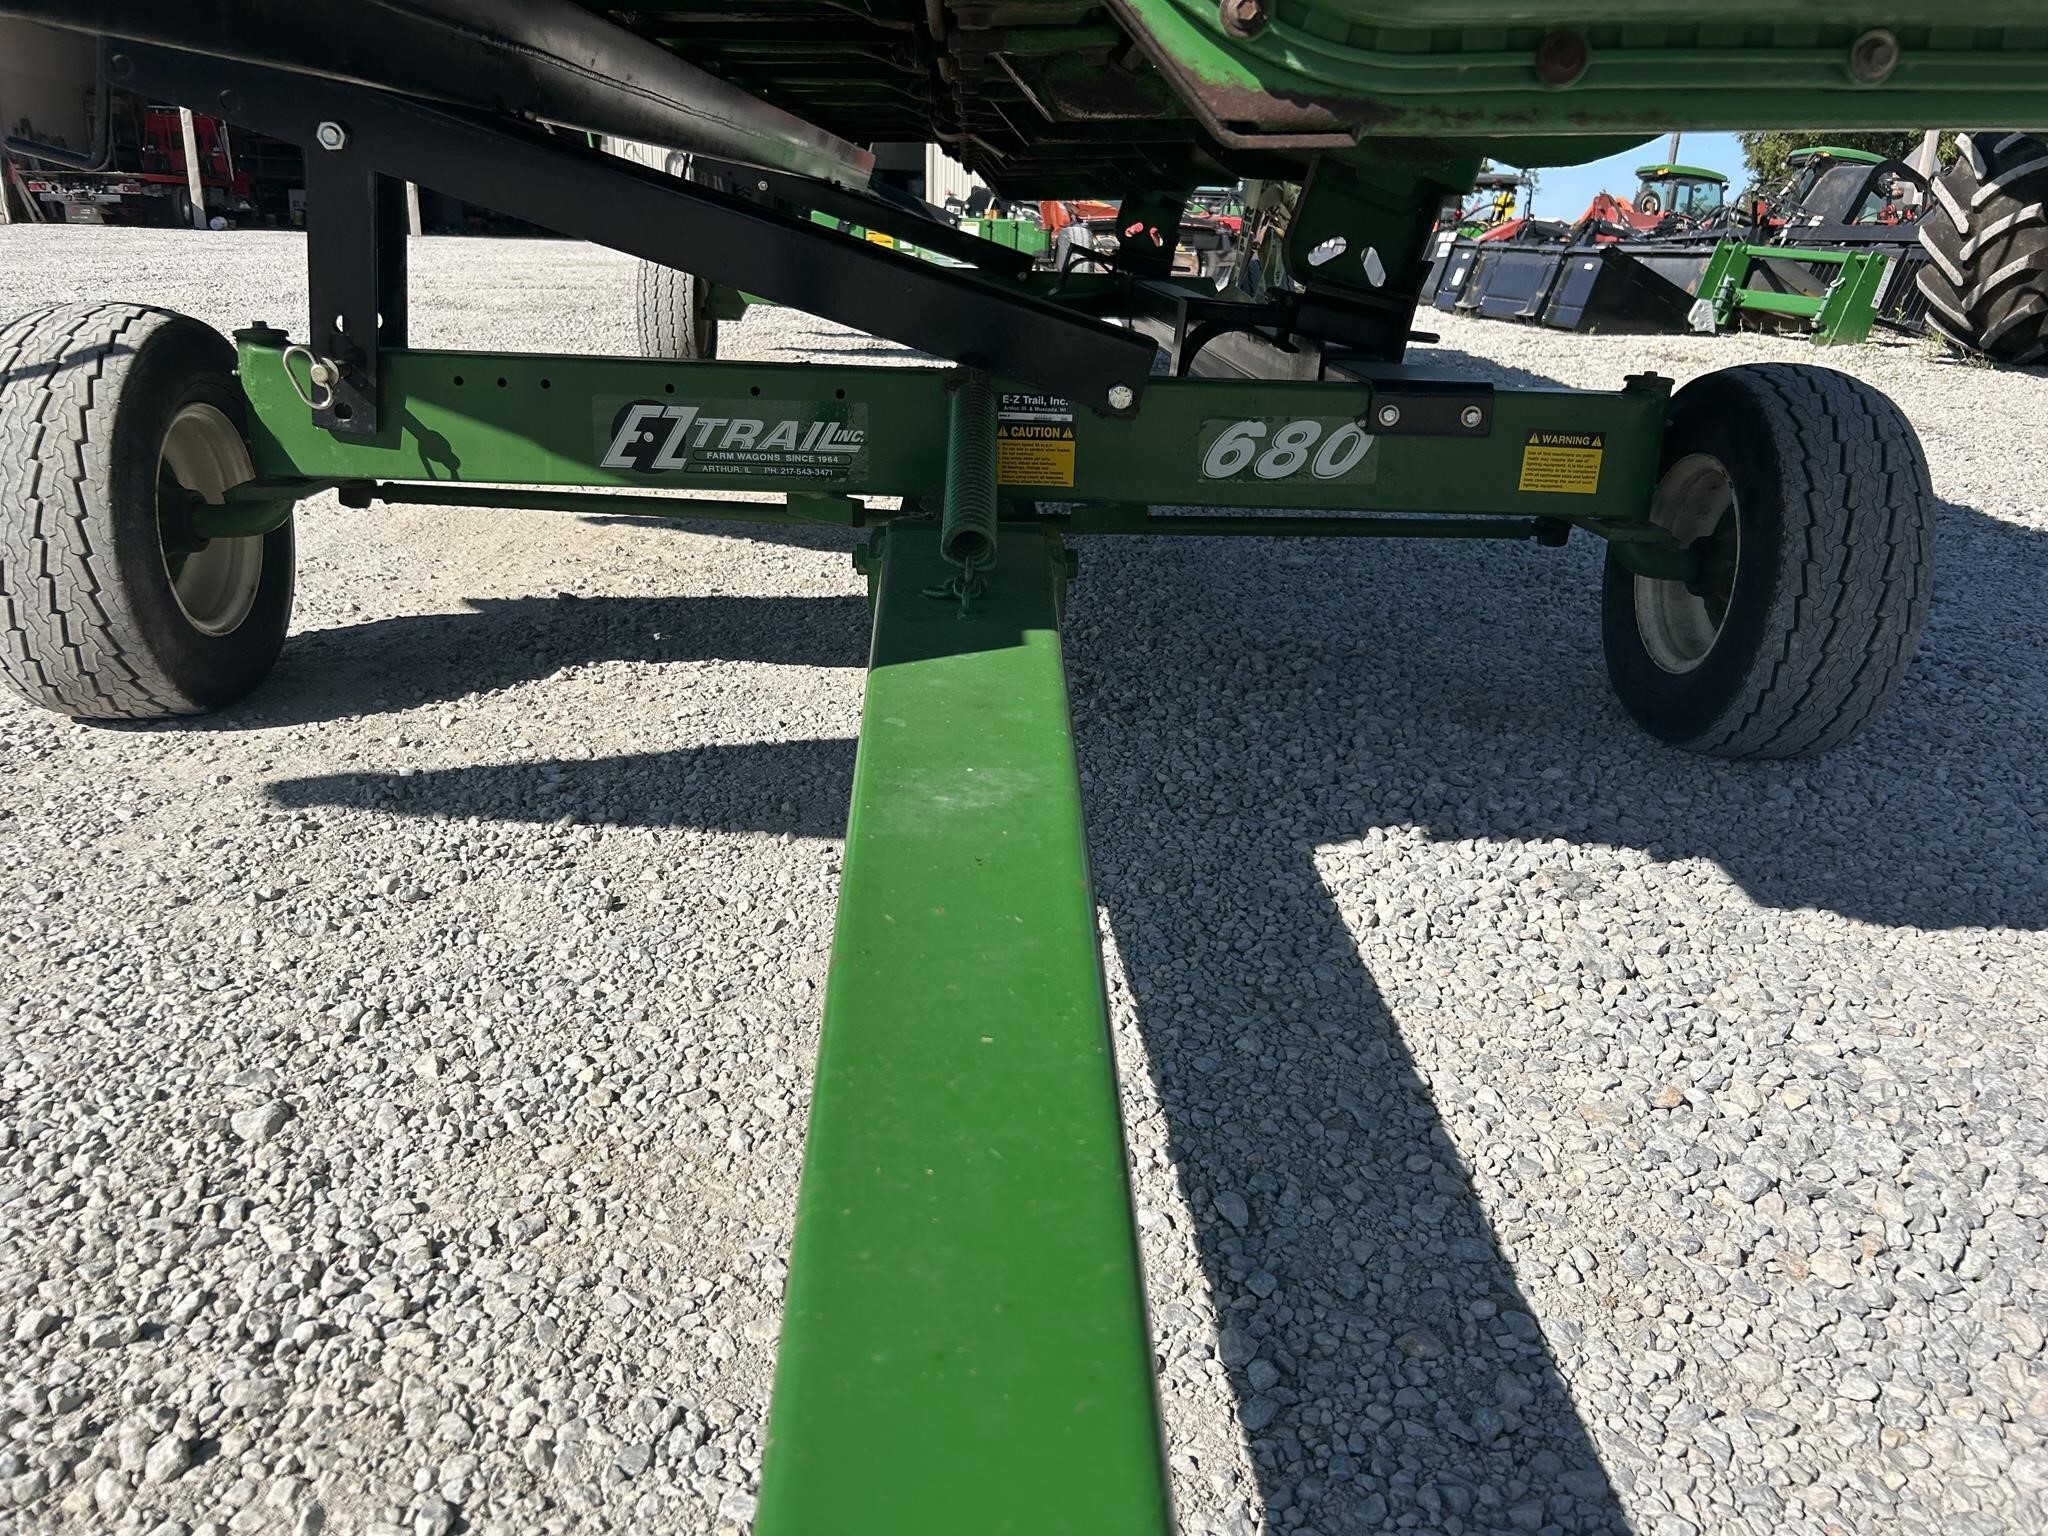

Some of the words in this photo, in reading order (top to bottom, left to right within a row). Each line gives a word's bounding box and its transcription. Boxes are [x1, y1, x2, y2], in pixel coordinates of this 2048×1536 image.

[1002, 394, 1020, 404] E-Z
[1022, 395, 1047, 406] Trail,
[1050, 396, 1069, 406] Inc.
[692, 417, 862, 454] TRAIL
[833, 430, 865, 443] INC.
[1011, 426, 1060, 438] CAUTION
[1542, 434, 1590, 446] WARNING
[1201, 420, 1375, 480] 680
[706, 452, 735, 461] FARM
[736, 453, 781, 462] WAGONS
[785, 454, 815, 463] SINCE
[817, 455, 839, 464] 1964
[780, 467, 833, 476] 217-543-3471
